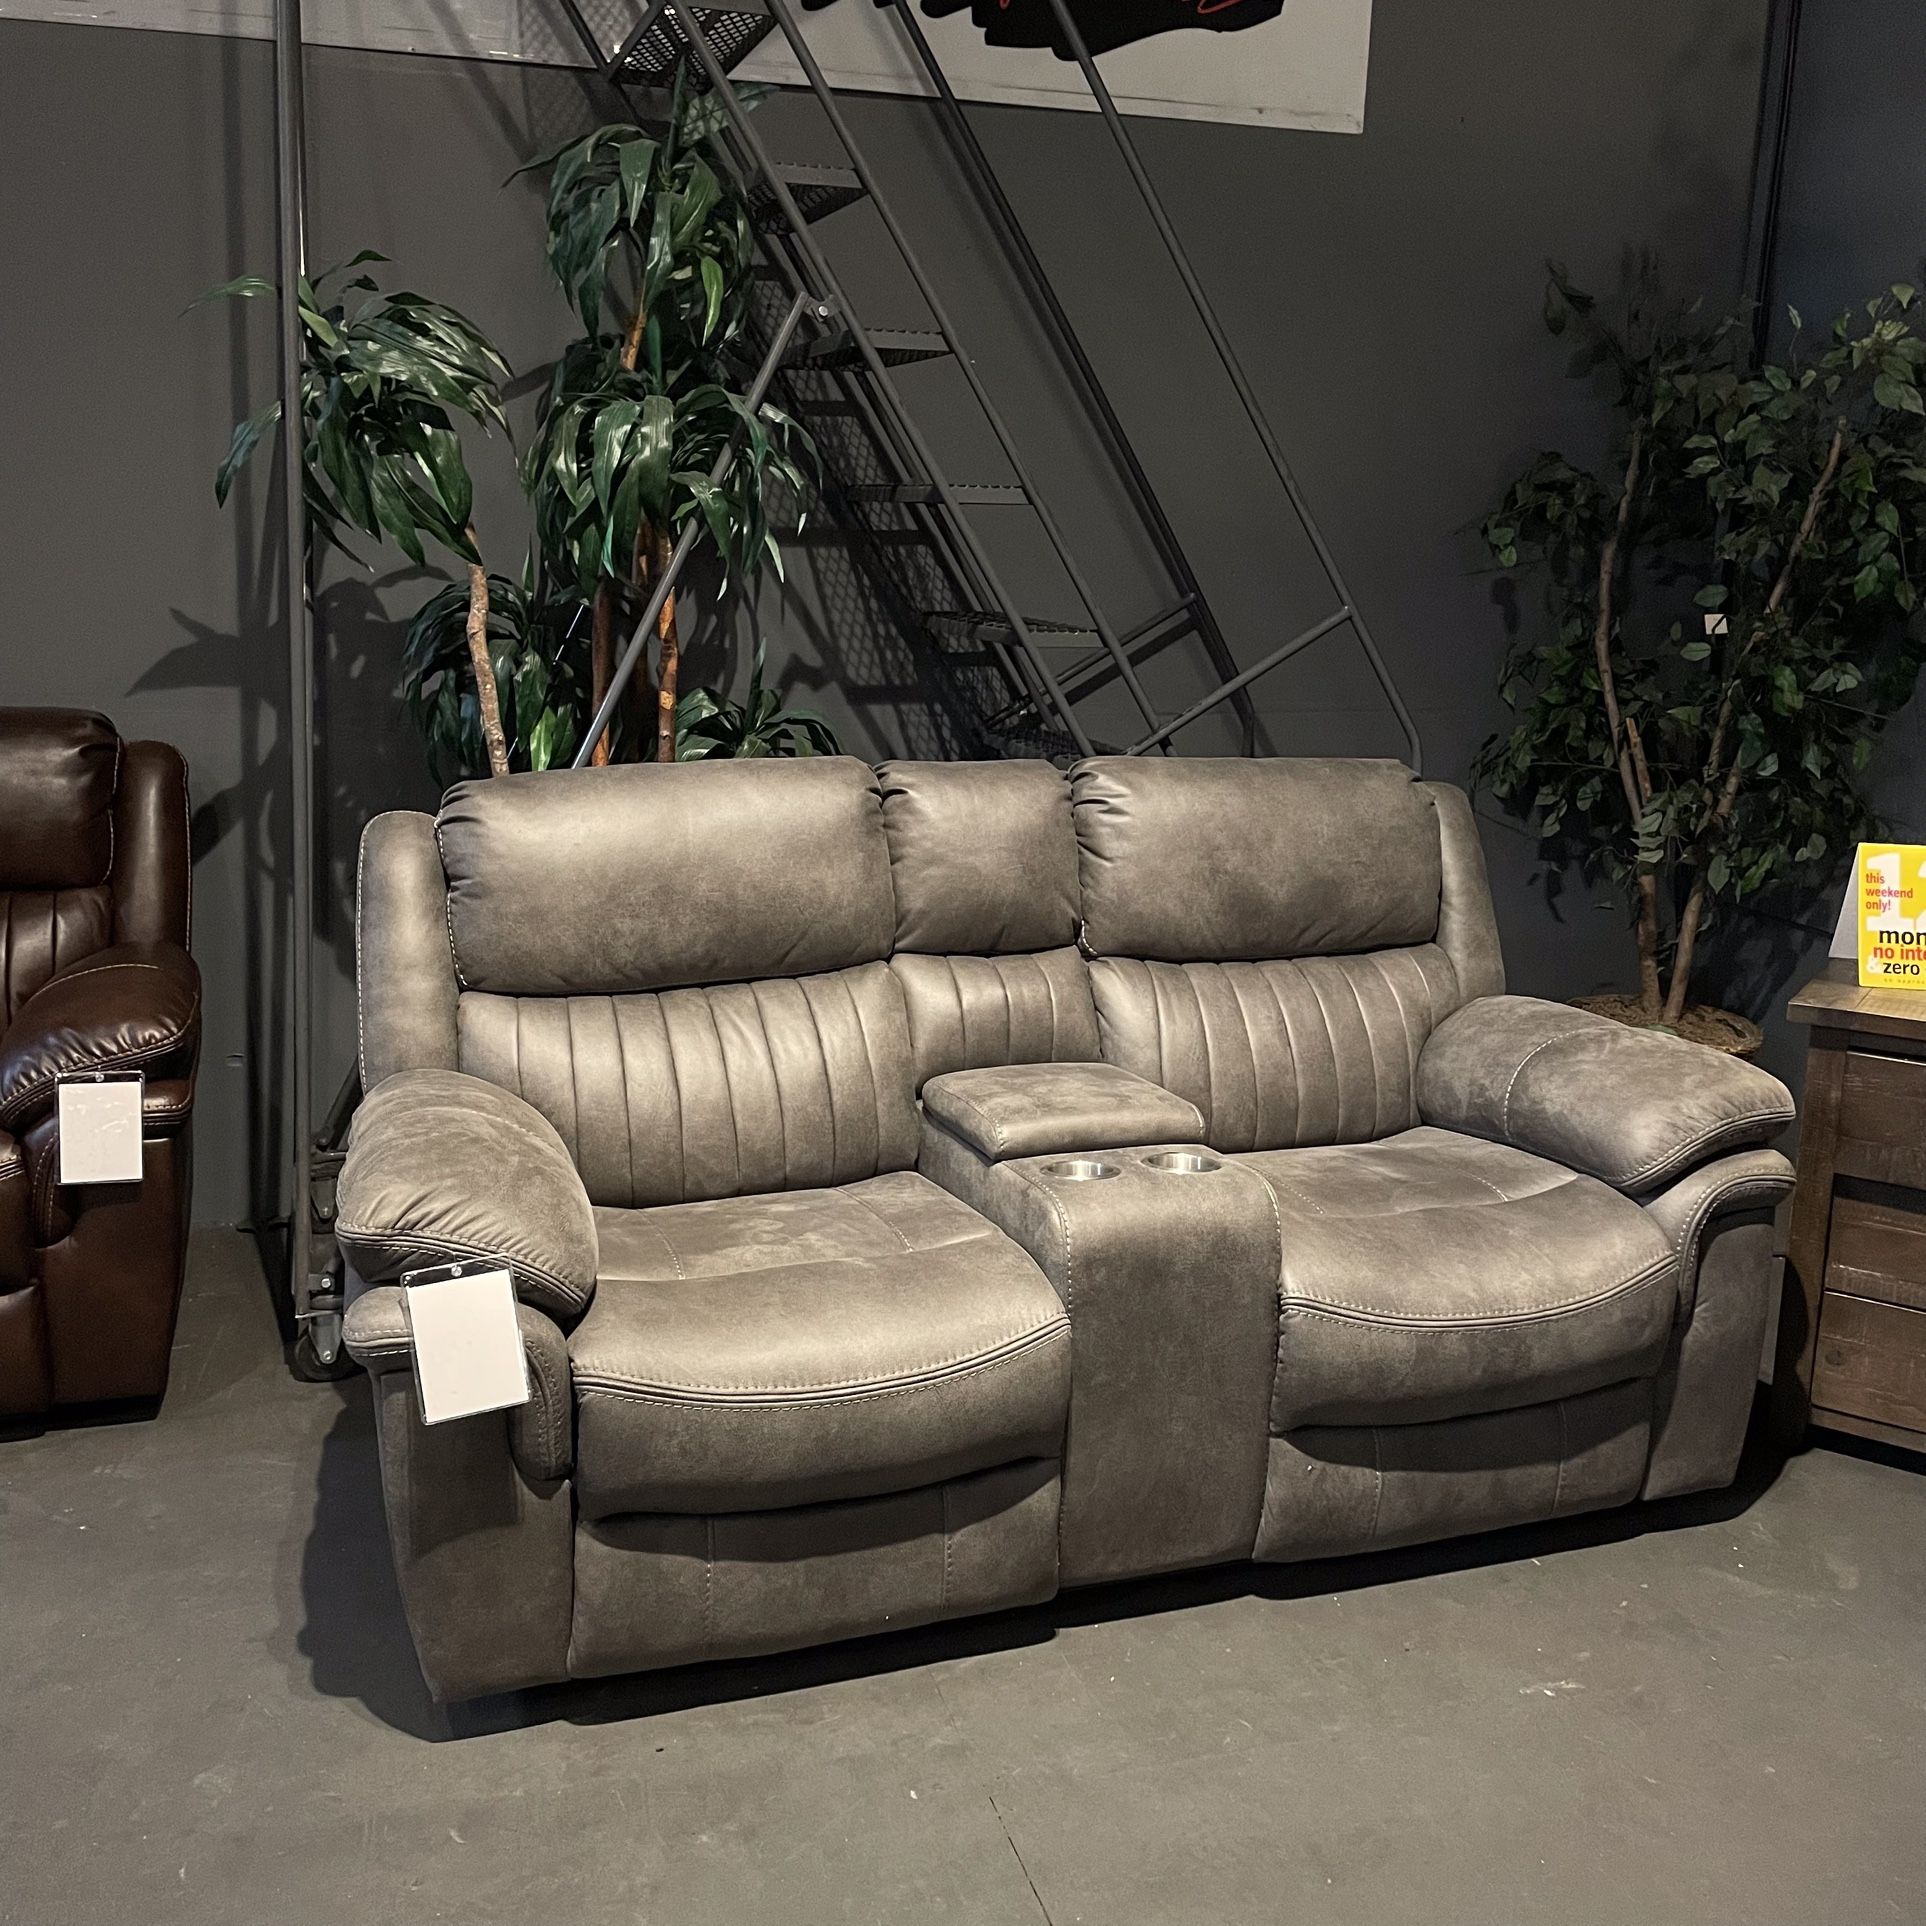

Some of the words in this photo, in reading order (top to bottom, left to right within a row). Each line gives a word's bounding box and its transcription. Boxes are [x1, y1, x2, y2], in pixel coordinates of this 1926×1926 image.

[1866, 873, 1885, 884] this
[1865, 852, 1926, 932] 1
[1866, 886, 1913, 899] weekend
[1866, 899, 1891, 913] only!
[1873, 946, 1895, 960] no
[1882, 962, 1920, 976] zero
